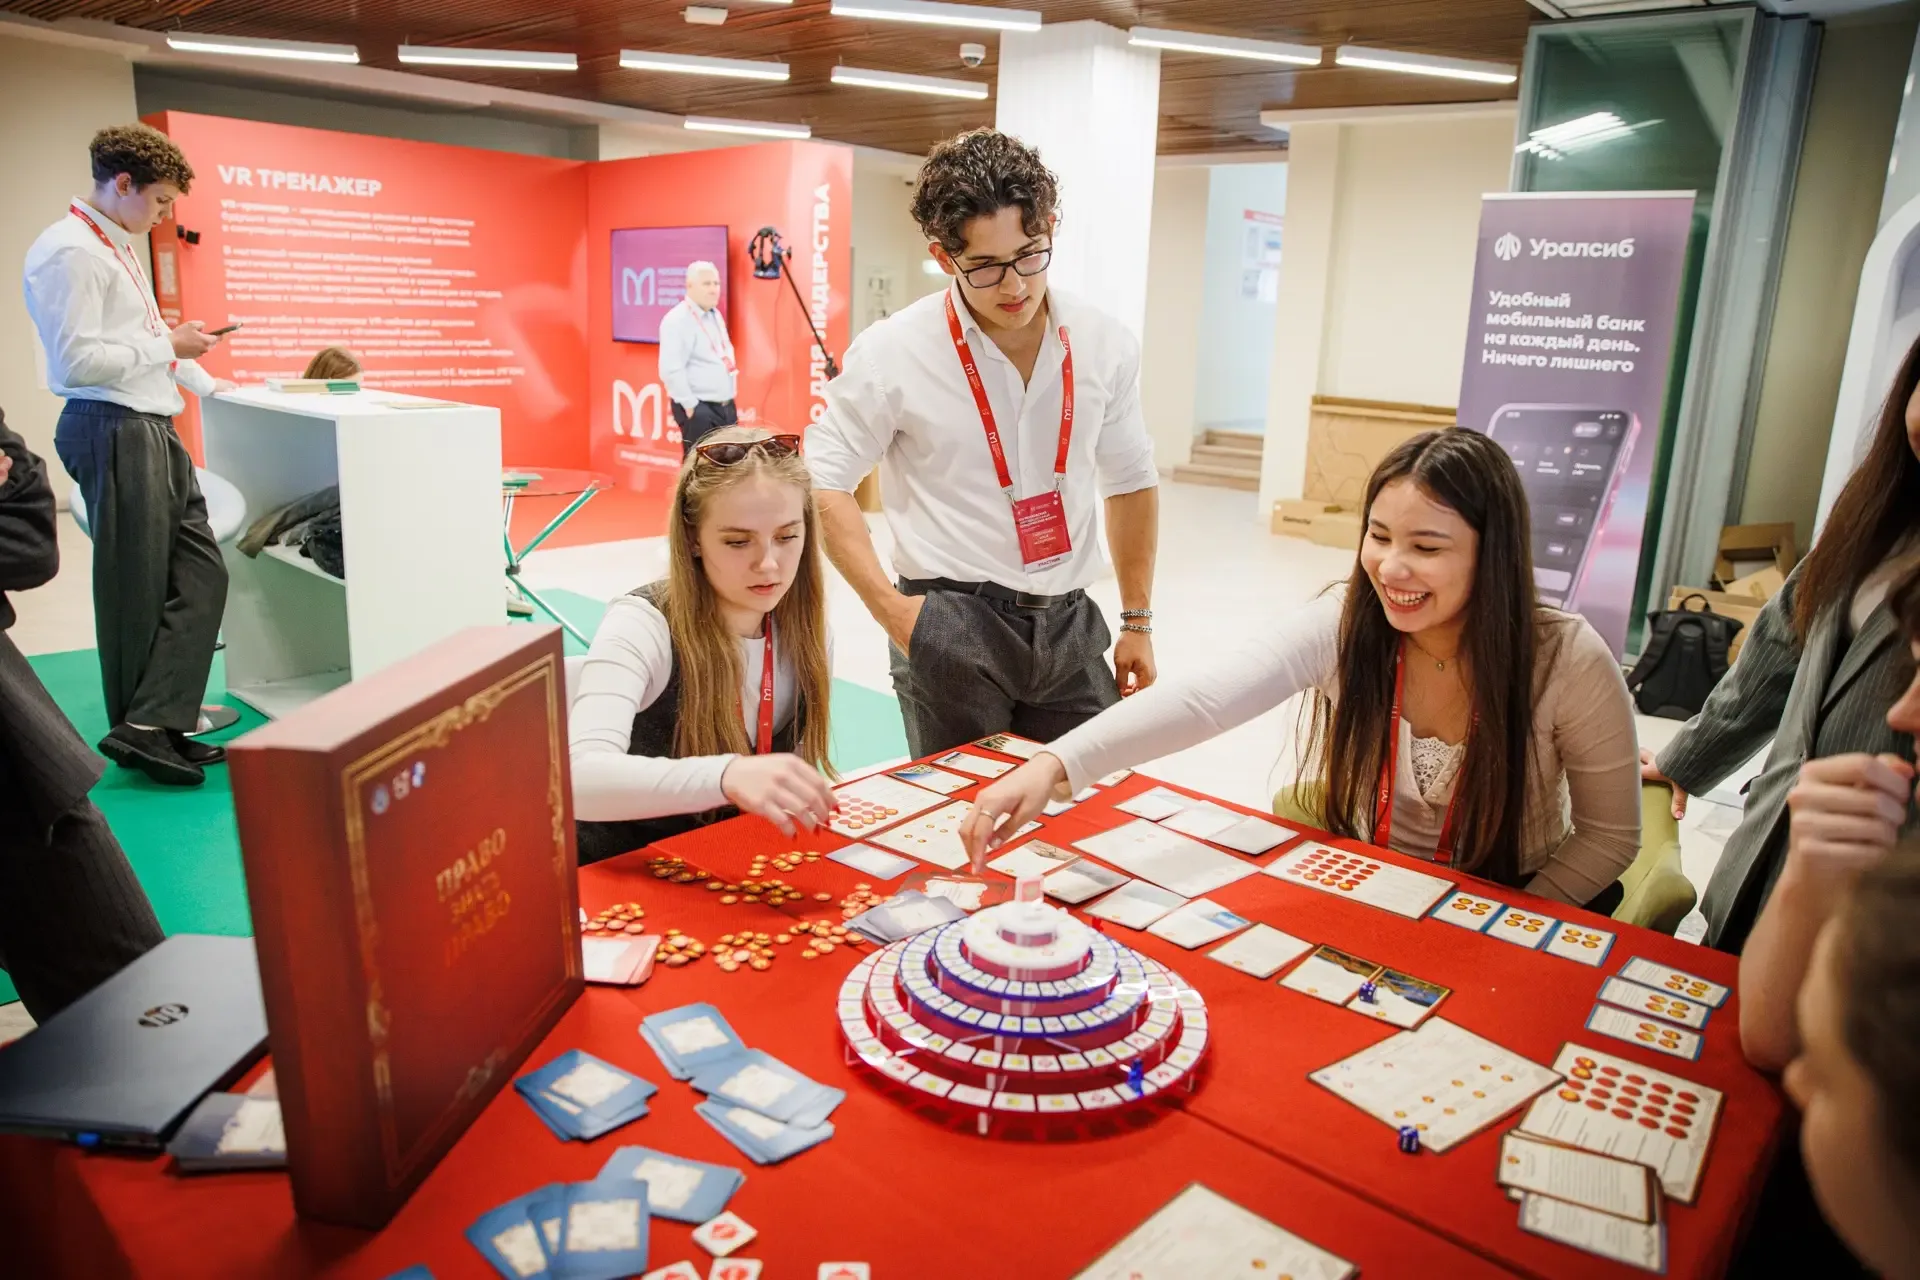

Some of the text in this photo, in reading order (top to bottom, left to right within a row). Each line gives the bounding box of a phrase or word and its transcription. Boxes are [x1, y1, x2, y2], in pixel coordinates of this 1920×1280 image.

[218, 165, 382, 196] VR ТРЕНАЖЕР
[1529, 237, 1635, 260] Уралсиб
[1488, 290, 1571, 308] Удобный
[1486, 312, 1646, 332] мобильный банк
[1484, 333, 1641, 353] на каждый день.
[1482, 350, 1634, 374] Ничего лишнего
[436, 828, 506, 903] ПРАВО
